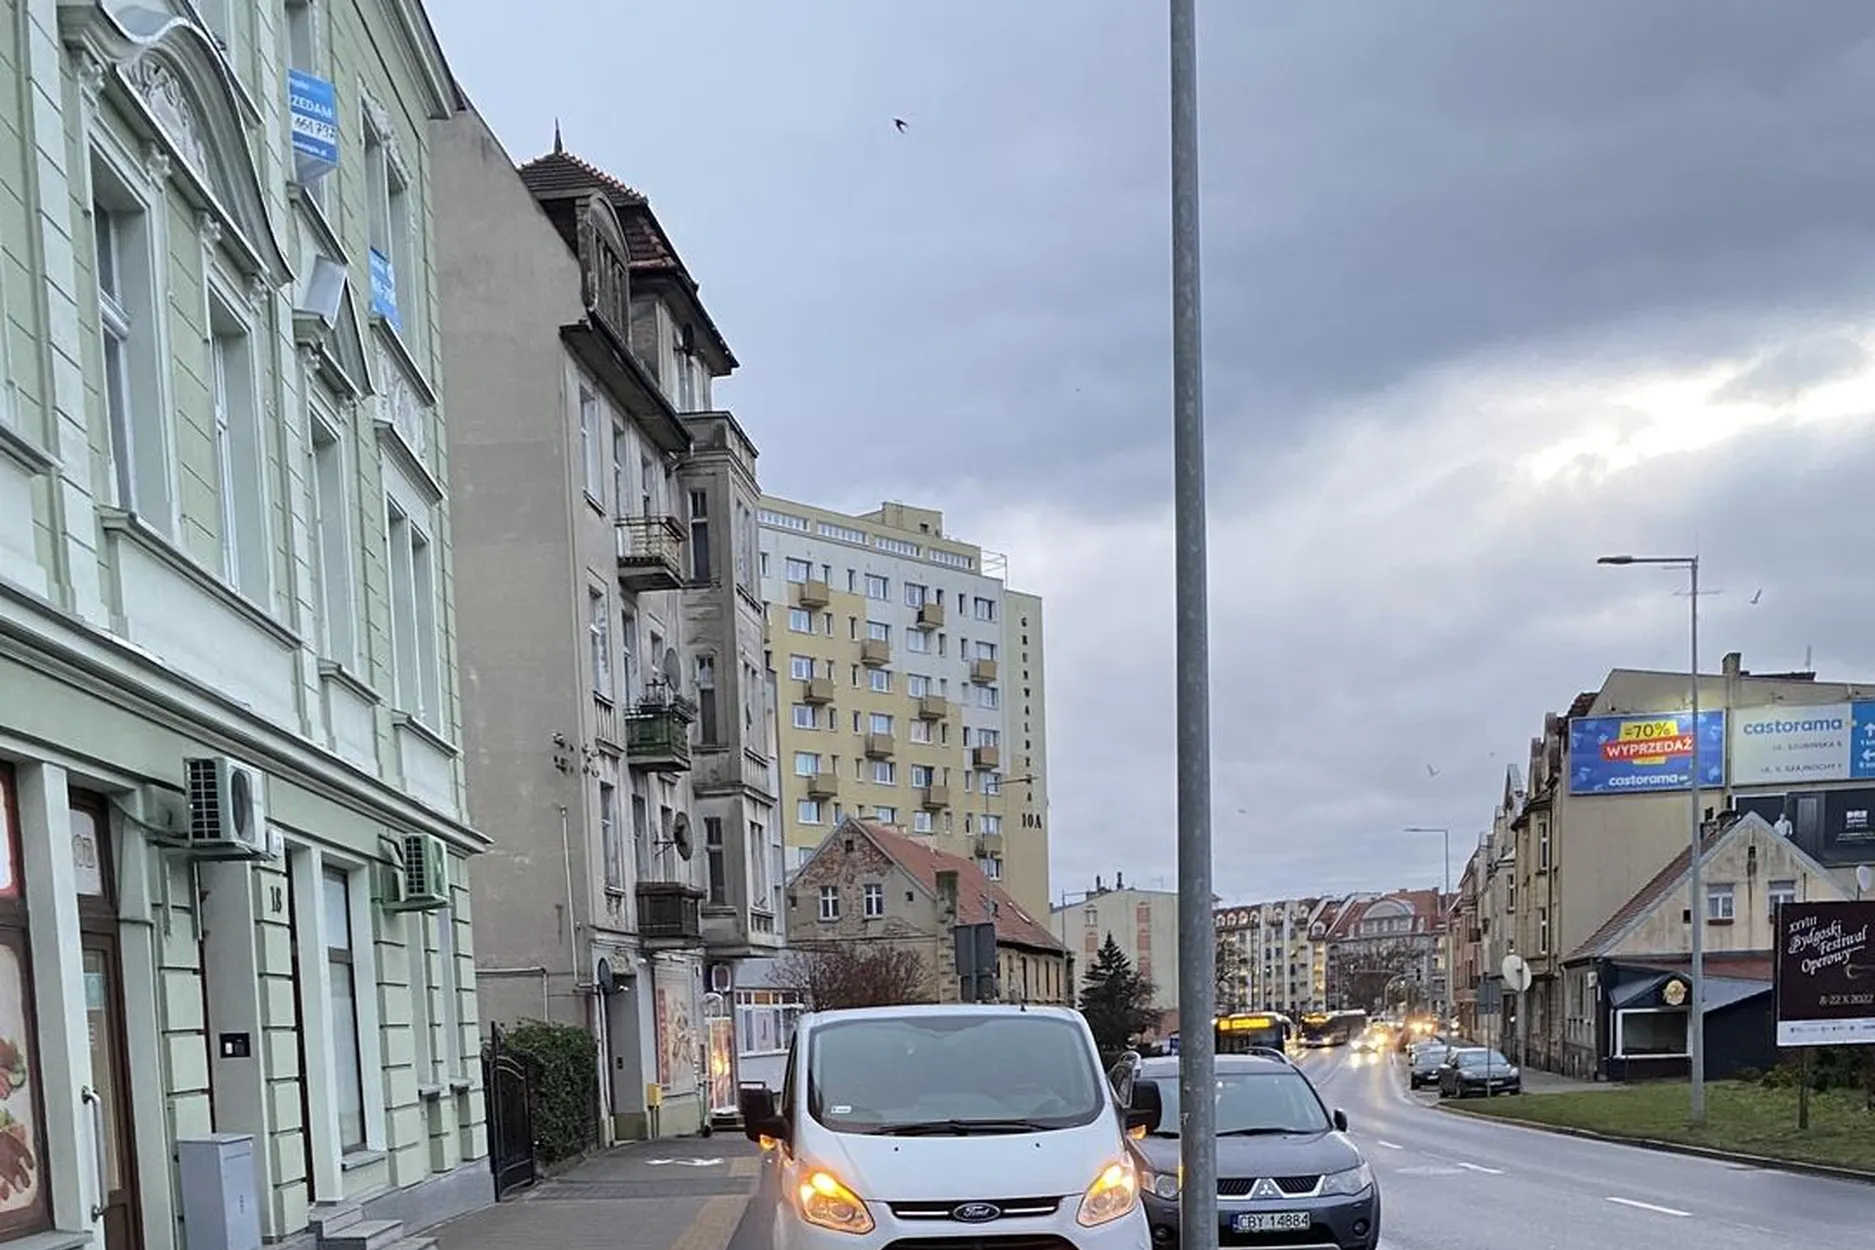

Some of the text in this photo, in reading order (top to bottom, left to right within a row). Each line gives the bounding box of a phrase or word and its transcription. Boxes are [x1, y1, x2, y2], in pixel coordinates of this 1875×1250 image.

[1743, 718, 1843, 736] castorama
[1606, 736, 1693, 757] WYPRZEDAŻ
[1608, 773, 1678, 787] castorama
[1022, 813, 1042, 829] 10A
[1788, 919, 1842, 954] Bydgoski
[1818, 924, 1868, 955] Festiwal
[1801, 945, 1866, 976] Operowy
[963, 1205, 990, 1217] Ford
[1240, 1212, 1309, 1229] CBY 14884
